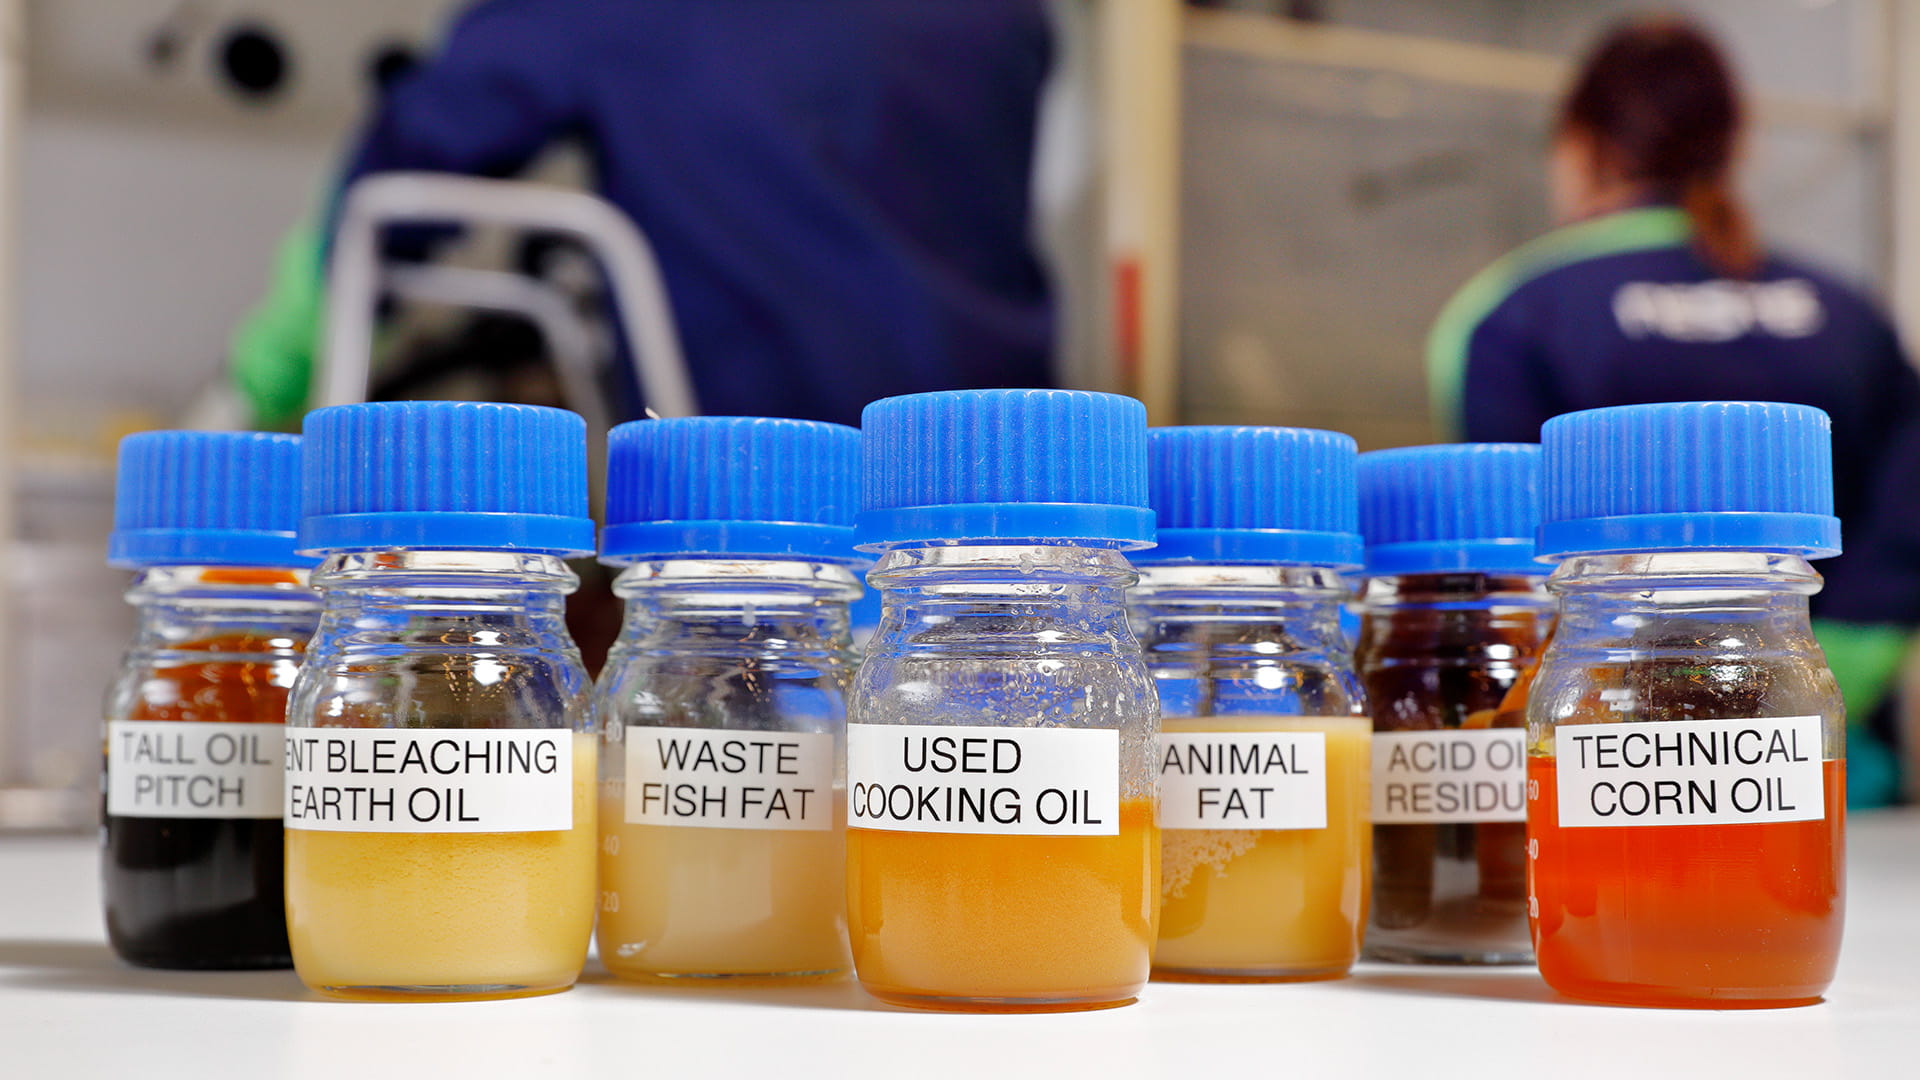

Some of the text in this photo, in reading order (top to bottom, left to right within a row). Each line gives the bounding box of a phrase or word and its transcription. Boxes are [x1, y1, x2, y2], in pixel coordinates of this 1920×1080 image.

[120, 731, 272, 766] TALL OIL
[327, 738, 558, 774] BLEACHING
[657, 738, 799, 775] WASTE
[903, 736, 1021, 774] USED
[1161, 743, 1309, 775] ANIMAL
[1388, 741, 1476, 773] ACID
[1573, 728, 1808, 769] TECHNICAL
[134, 774, 245, 808] PITCH
[291, 785, 480, 822] EARTH OIL
[642, 783, 815, 820] FISH FAT
[853, 781, 1102, 825] COOKING OIL
[1198, 787, 1275, 819] FAT
[1590, 777, 1796, 817] CORN OIL
